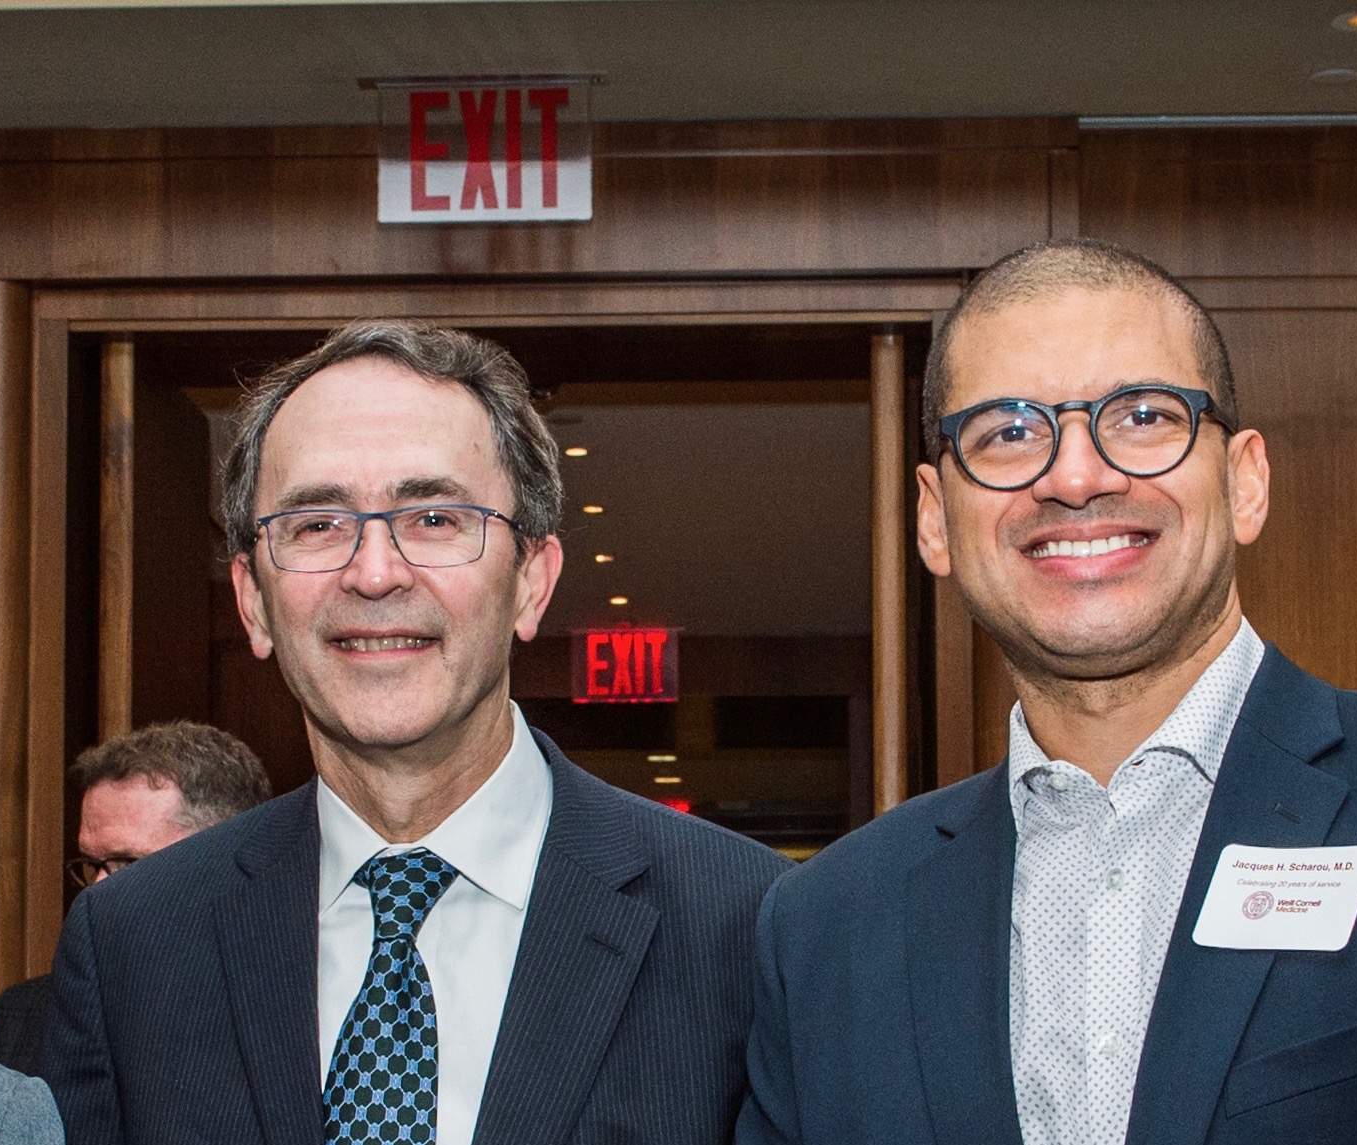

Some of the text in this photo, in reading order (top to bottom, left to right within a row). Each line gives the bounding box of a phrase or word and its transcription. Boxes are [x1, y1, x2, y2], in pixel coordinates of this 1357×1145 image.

[409, 87, 570, 211] EXIT
[586, 632, 668, 696] EXIT
[1232, 860, 1274, 872] Jacques
[1276, 863, 1286, 871] H.
[1333, 861, 1354, 871] M.D.
[1236, 878, 1277, 889] Celebrating
